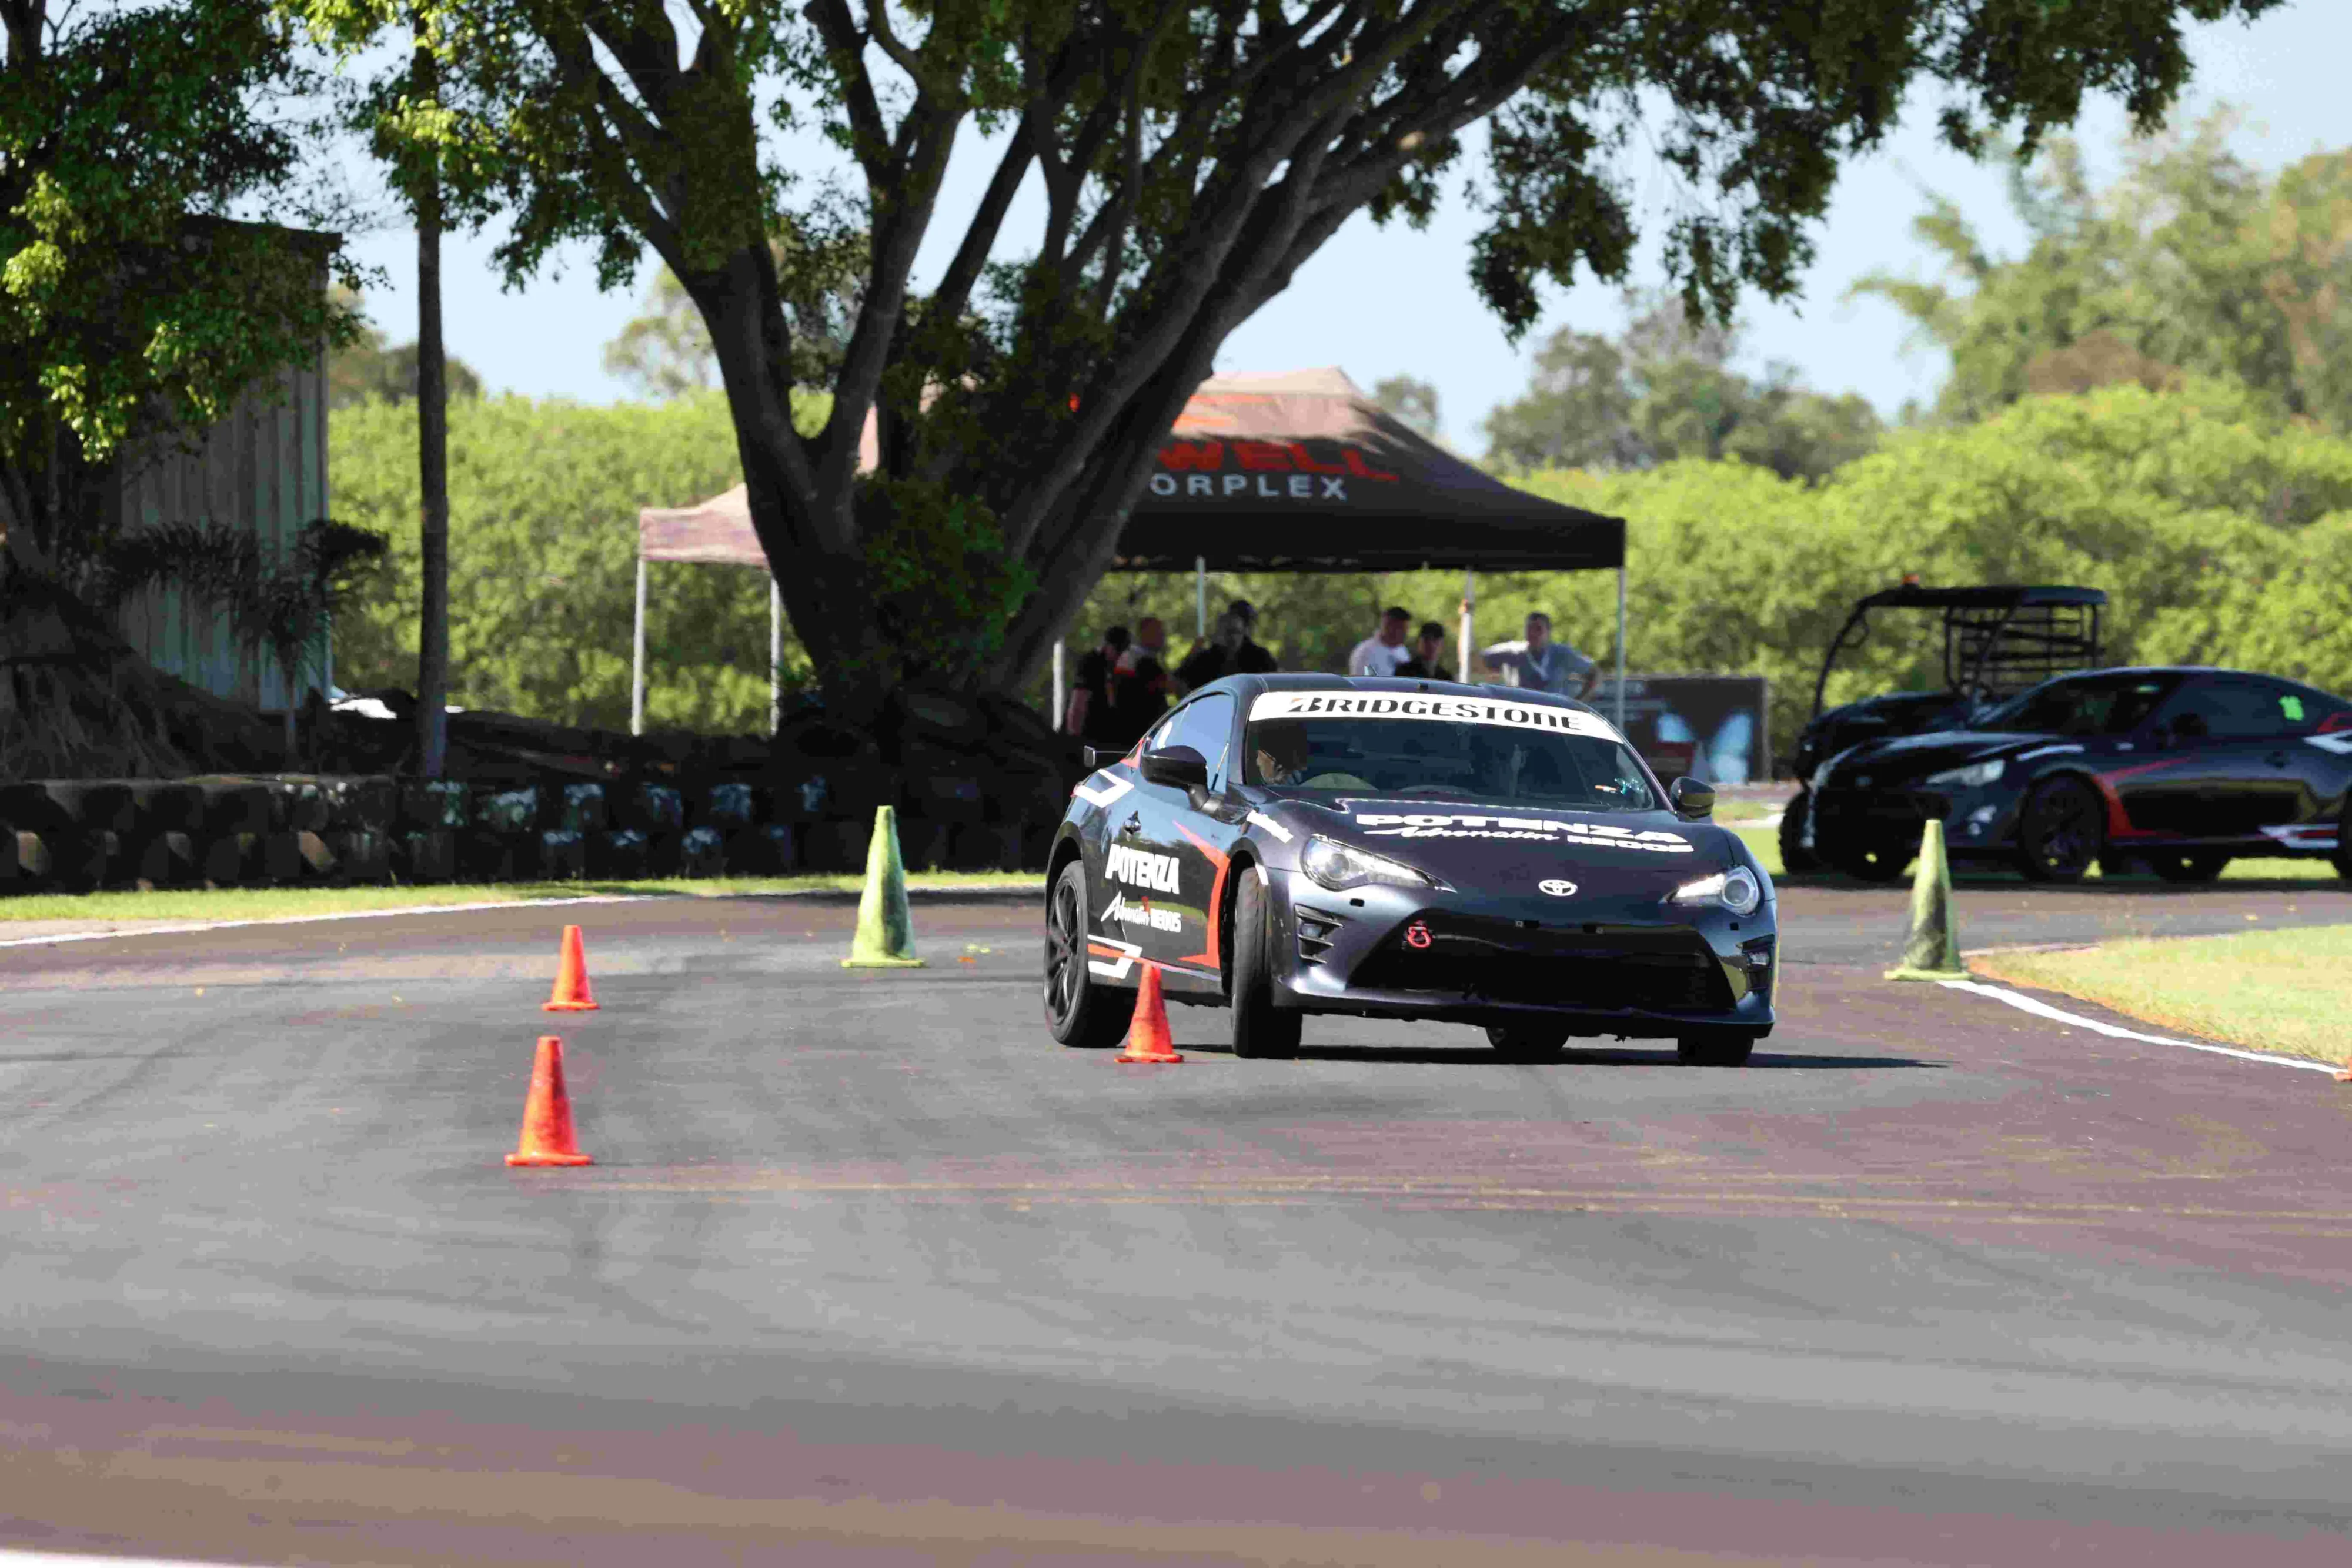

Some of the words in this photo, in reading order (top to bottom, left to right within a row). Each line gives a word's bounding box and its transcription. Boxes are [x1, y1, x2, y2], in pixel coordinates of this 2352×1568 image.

[1287, 697, 1582, 731] BRIDGESTONE
[1356, 814, 1688, 844] POTENZA
[1104, 843, 1180, 895] POTENZA
